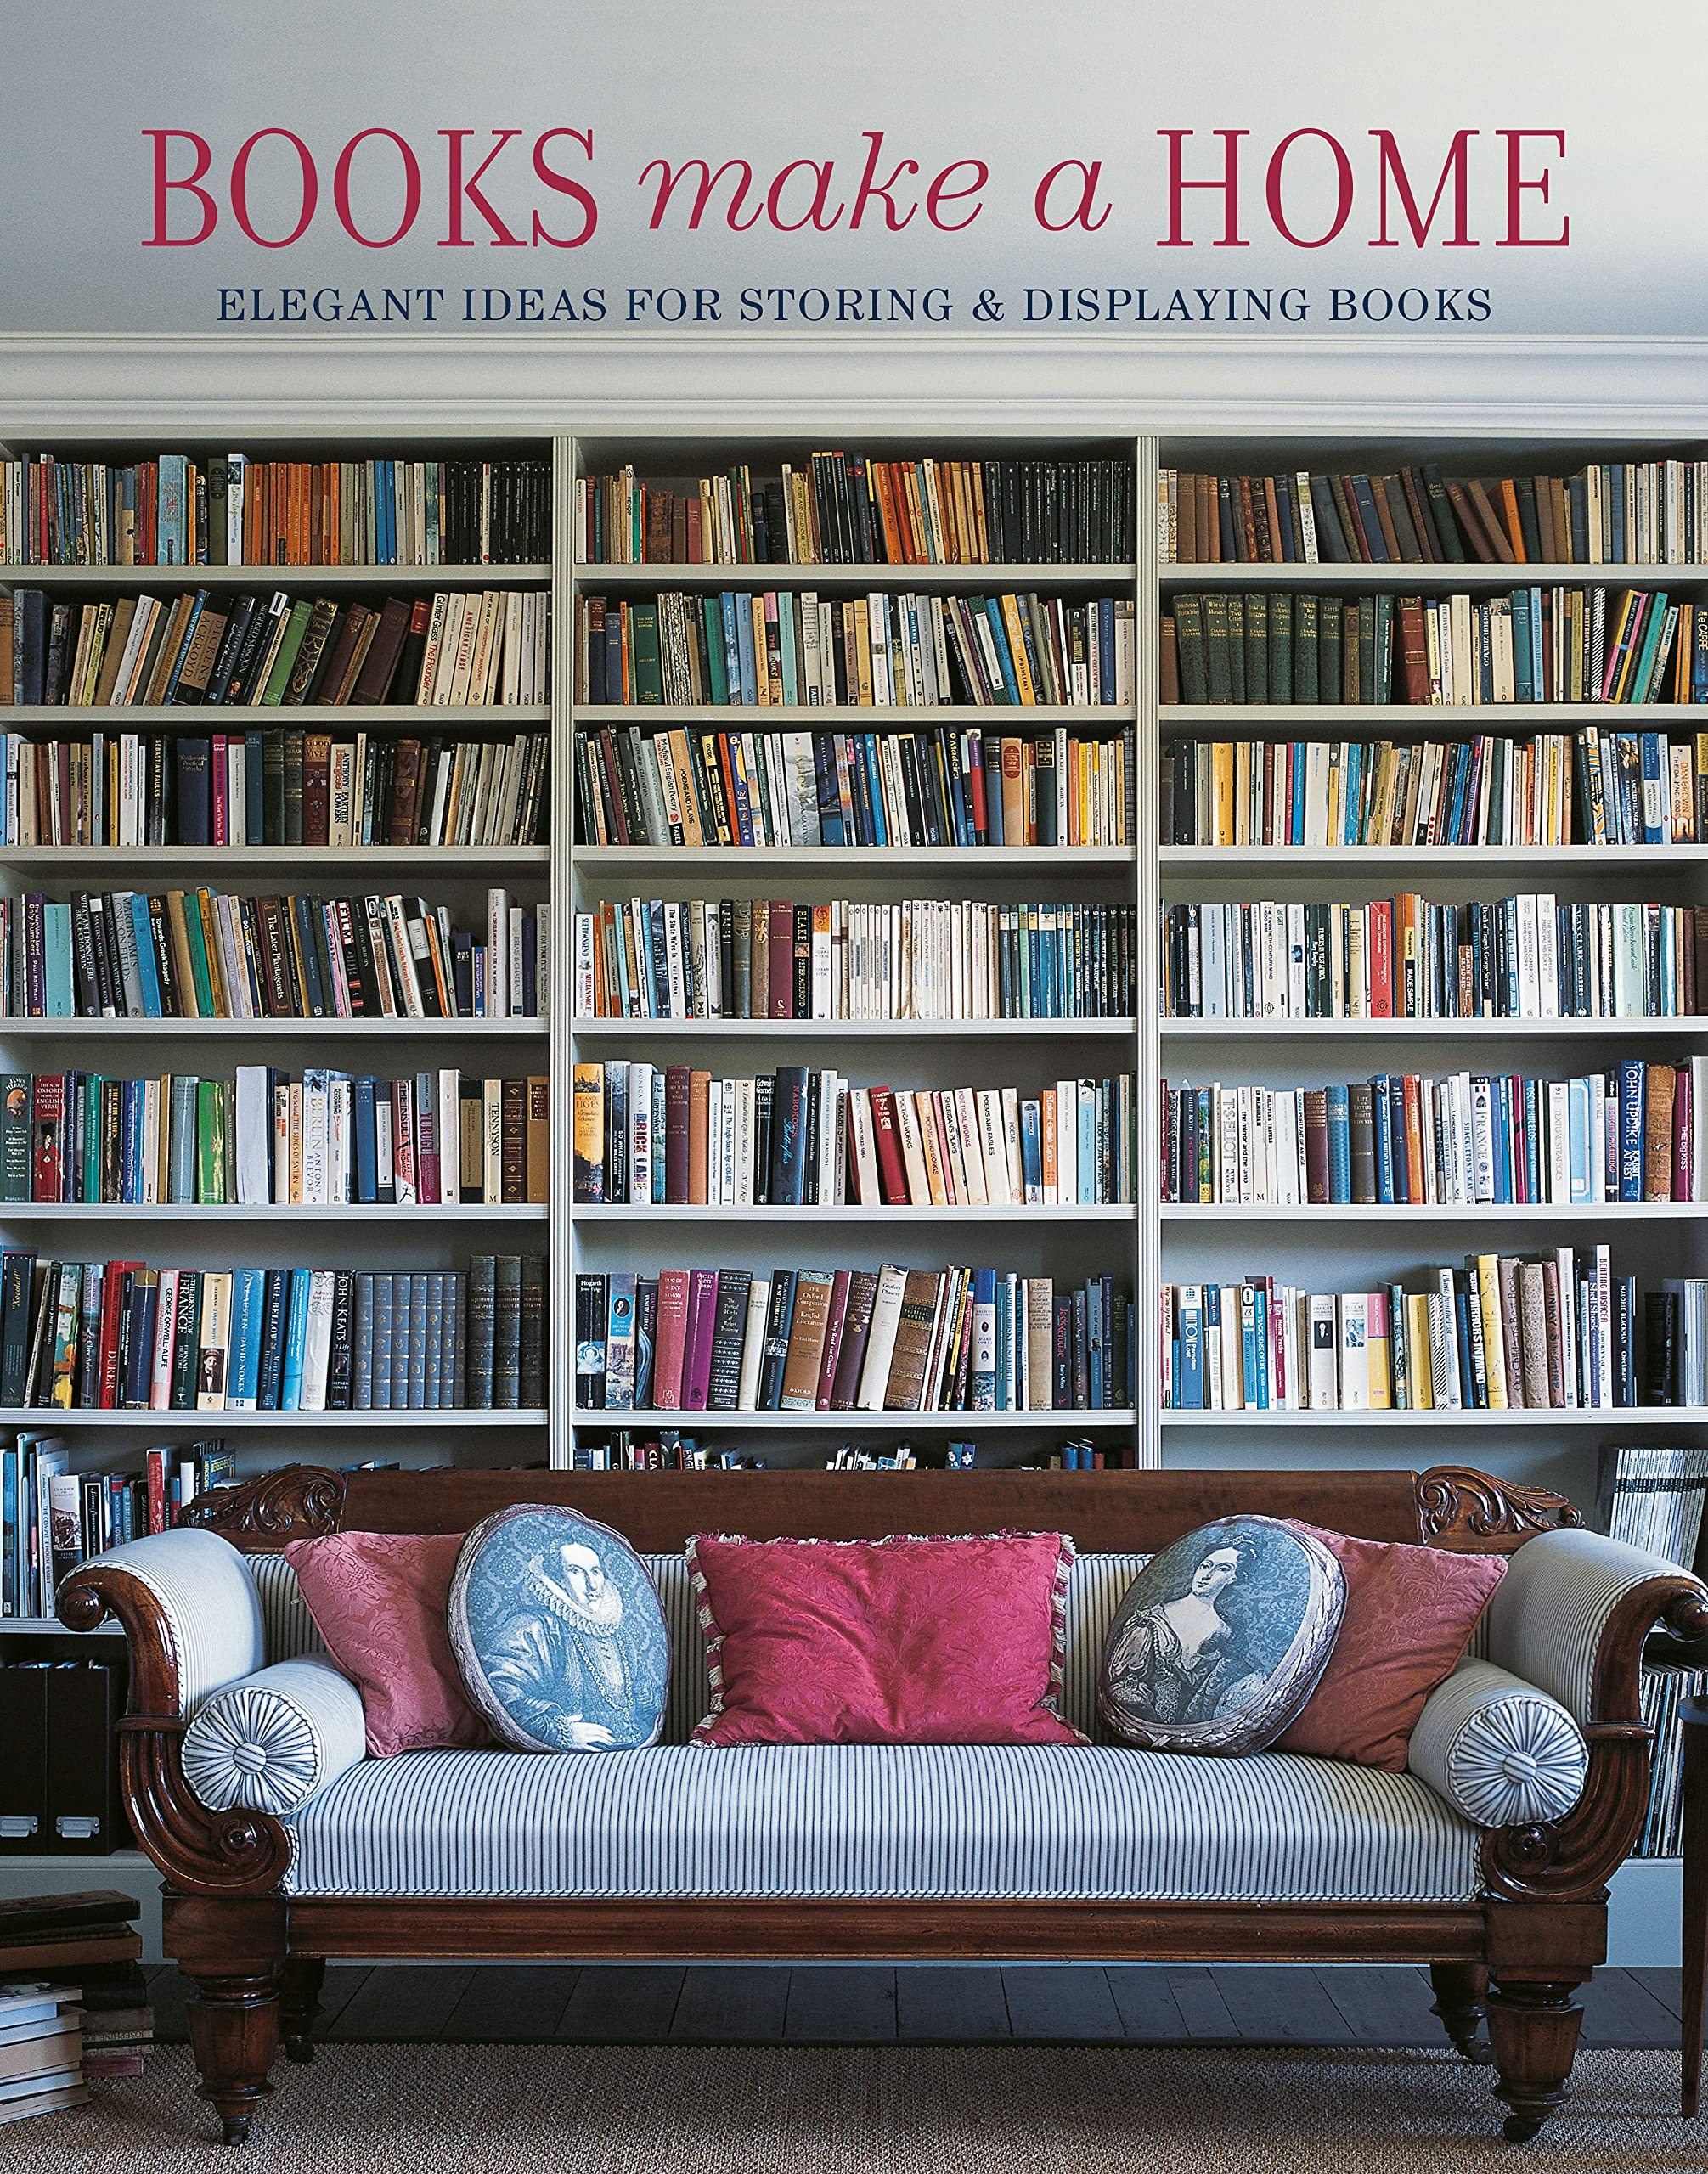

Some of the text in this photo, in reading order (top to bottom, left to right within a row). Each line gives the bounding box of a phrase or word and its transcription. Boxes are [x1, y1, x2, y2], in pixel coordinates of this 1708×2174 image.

[183, 616, 208, 678] ACKROYD
[198, 620, 224, 682] DICKENS
[239, 603, 268, 673] SIEGFRIED SASSOON
[423, 596, 446, 690] Günter Grass The Flounder
[660, 738, 677, 811] Medieval English Poetry
[950, 741, 959, 780] Madeira
[113, 897, 131, 982] LONDON FIELDS
[122, 897, 138, 966] MARTIN AMIS
[155, 917, 170, 984] Towards Greek Tragedy
[581, 918, 589, 929] SUE
[798, 911, 806, 941] BLAKE
[268, 915, 284, 1000] The Later Plantagenets
[311, 1098, 324, 1149] BERLIN
[420, 1112, 433, 1153] YURUGU
[983, 1095, 991, 1117] POEMS
[1476, 1112, 1487, 1158] FRANCE
[1626, 1066, 1638, 1145] JOHN UPDIKE
[634, 1113, 647, 1190] BRICK LANE
[780, 1118, 794, 1164] Butterflies
[1624, 1149, 1631, 1159] AT
[1599, 1259, 1608, 1288] BEATING
[178, 1279, 189, 1334] FRANCE
[337, 1276, 348, 1341] JOHN KEATS
[1185, 1309, 1197, 1343] MILTON
[1469, 1294, 1485, 1383] MIRRORS IN MIND
